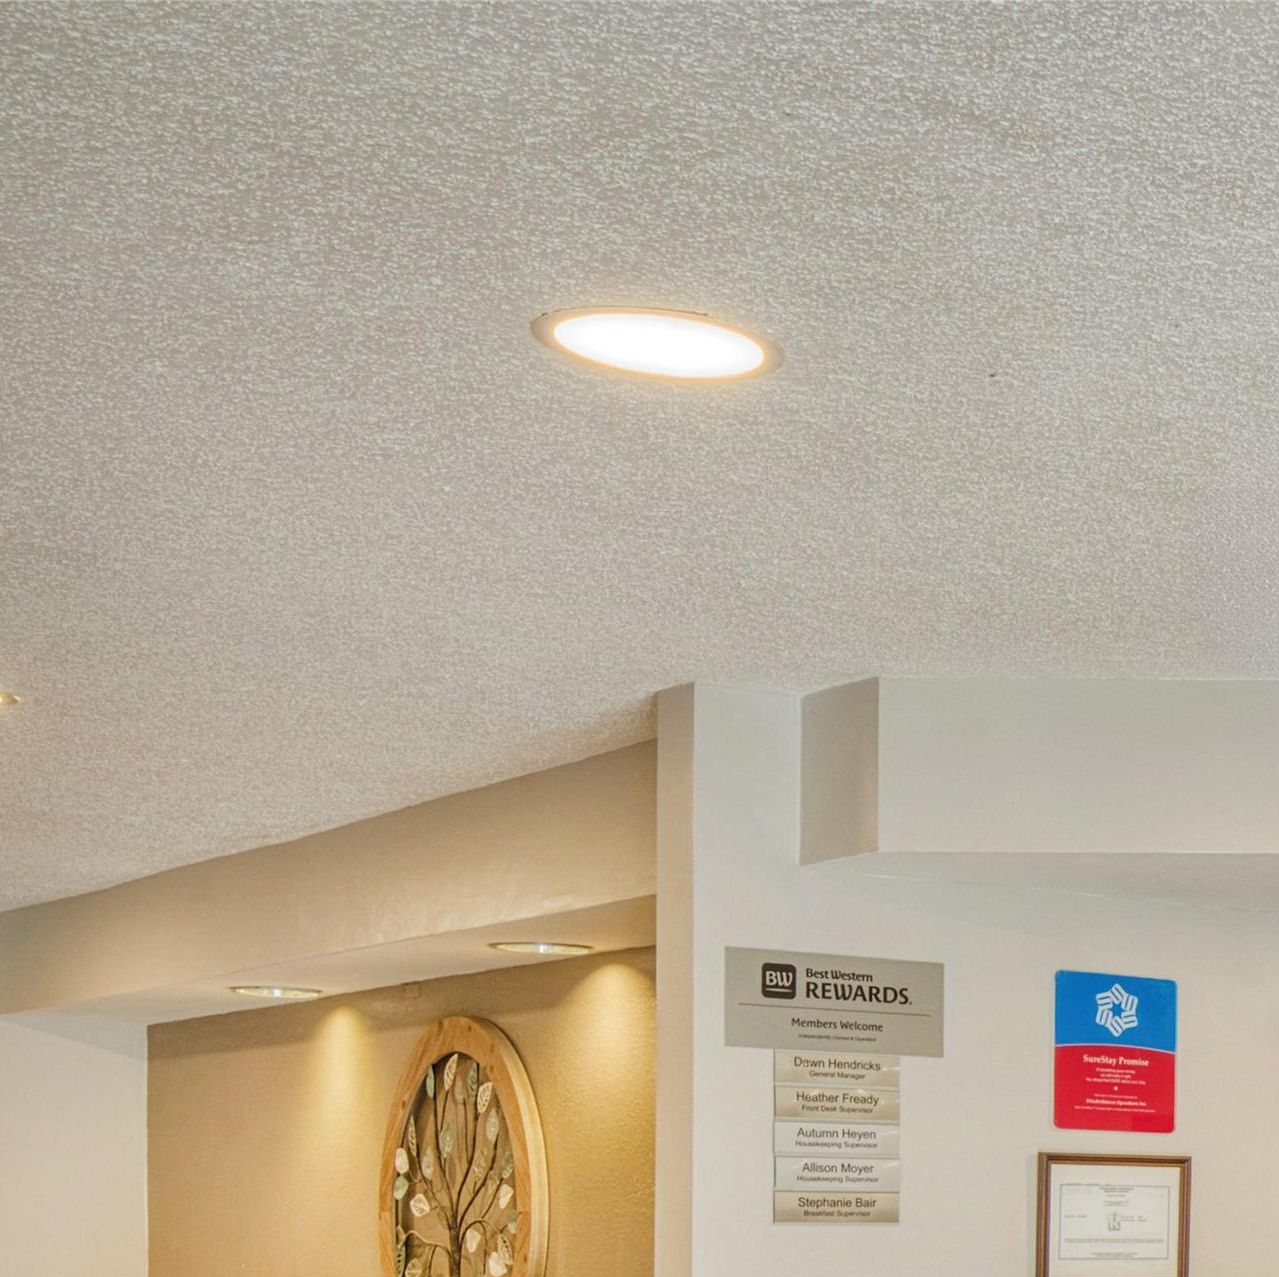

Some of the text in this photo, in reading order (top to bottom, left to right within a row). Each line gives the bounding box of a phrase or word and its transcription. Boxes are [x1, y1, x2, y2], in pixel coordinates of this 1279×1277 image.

[765, 970, 793, 987] BW
[806, 968, 873, 983] Best Western
[791, 1017, 883, 1032] Members Welcome
[828, 1058, 881, 1071] Hendricks
[1083, 1054, 1149, 1067] SureStay Promise
[797, 1091, 879, 1106] Heather Fready
[797, 1127, 876, 1141] Autumn Heyen
[802, 1162, 873, 1176] Allison Moyer
[798, 1197, 876, 1209] Stephanie Bair
